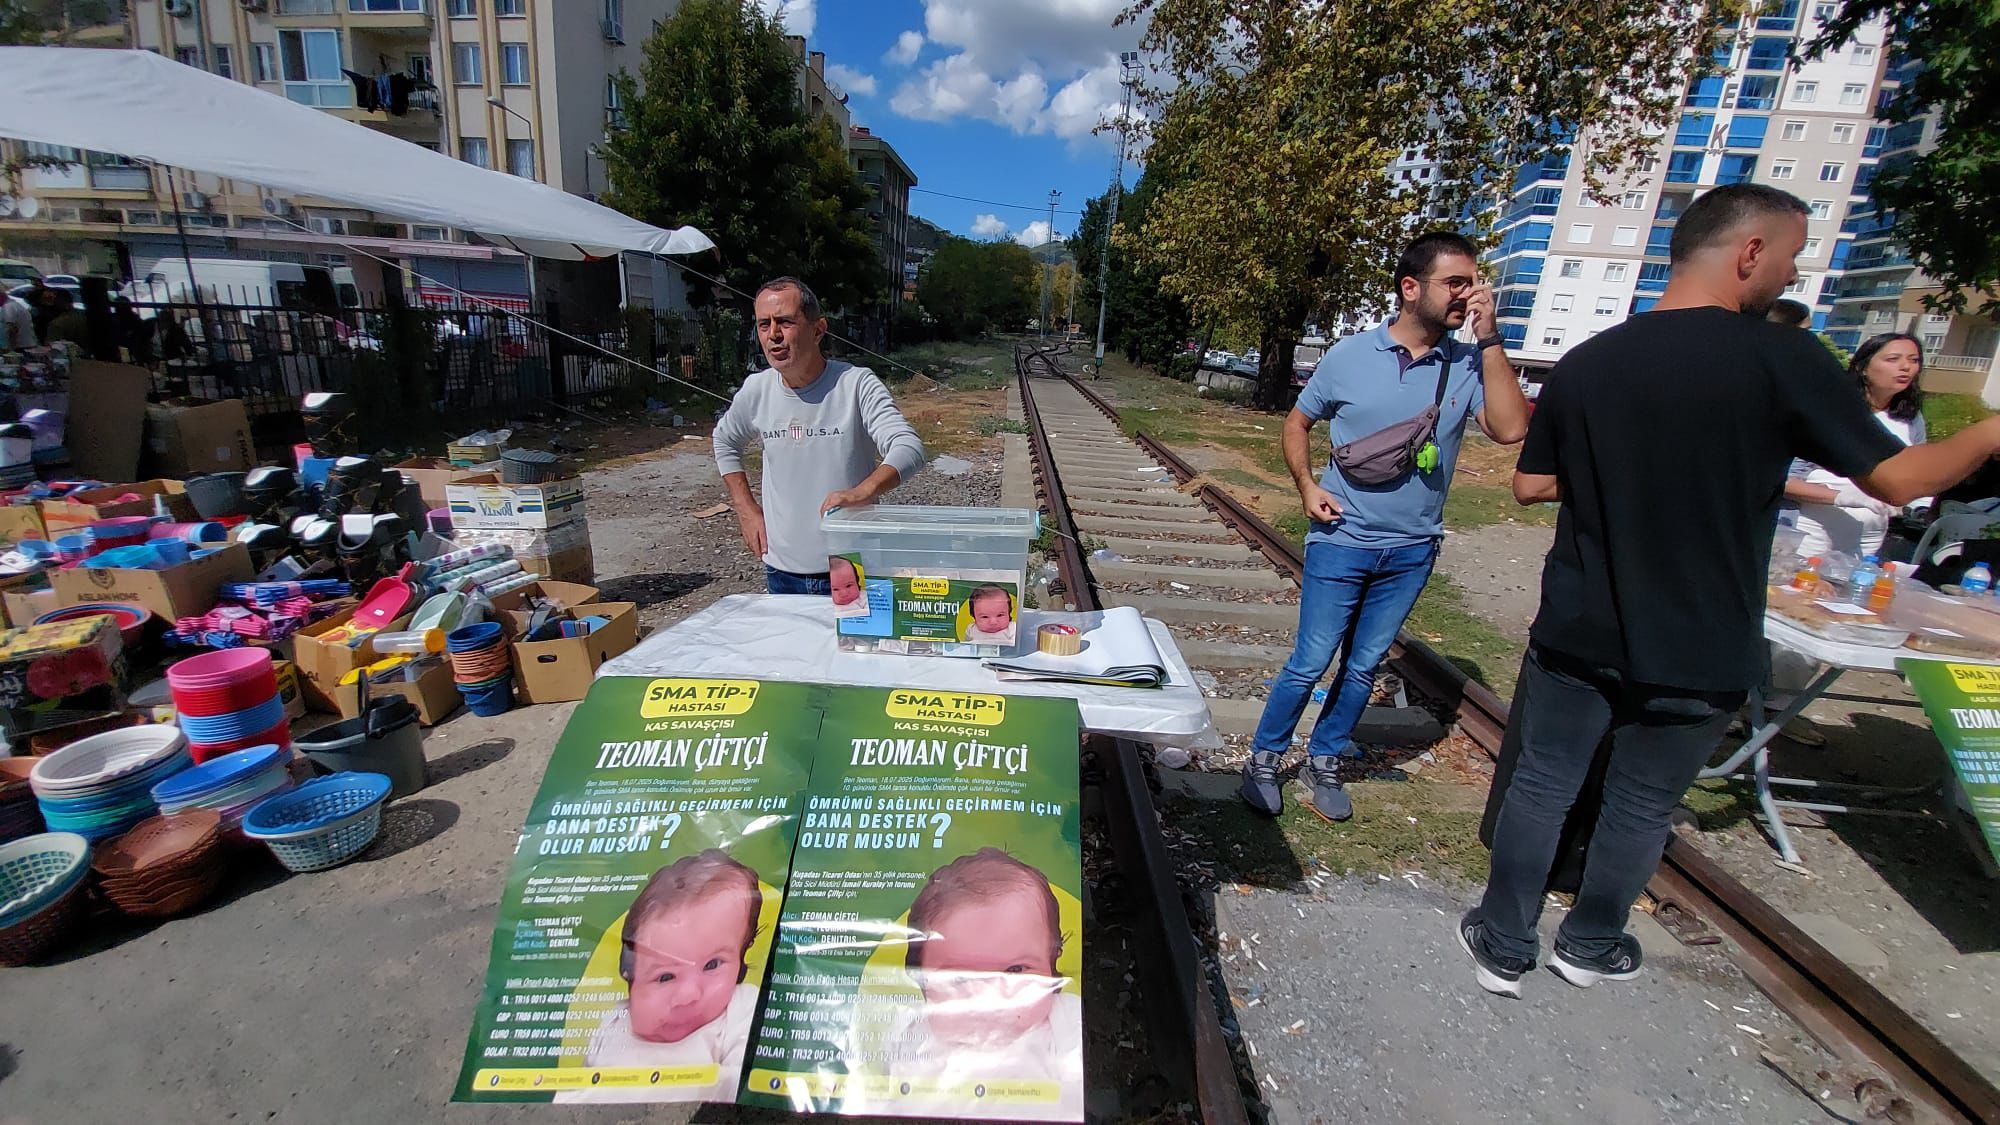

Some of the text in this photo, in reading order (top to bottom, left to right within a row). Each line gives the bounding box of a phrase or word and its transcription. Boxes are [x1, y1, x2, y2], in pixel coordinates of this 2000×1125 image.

[480, 501, 514, 516] BONITA
[897, 600, 960, 615] TEOMAN ÇİFTÇİ
[1954, 670, 1986, 680] SMA
[650, 682, 755, 701] SMA TİP-1
[668, 702, 726, 713] HASTASI
[894, 693, 1003, 712] SMA TİP-1
[916, 709, 976, 721] HASTASI
[644, 719, 735, 732] KAS SAVAŞÇISI
[894, 722, 990, 737] KAS SAVAŞÇISI
[595, 731, 769, 772] TEOMAN ÇİFTÇİ
[850, 738, 1029, 775] TEOMAN ÇİFTÇİ
[551, 795, 788, 816] ÖMRÜMÜ SAĞLIKLI GEÇİRMEM İÇİN
[809, 795, 1062, 816] ÖMRÜMÜ SAĞLIKLI GEÇİRMEM İÇİN
[545, 815, 659, 835] BANA DESTEK
[805, 813, 927, 829] BANA DESTEK
[539, 813, 681, 856] OLUR MUSUN ?
[800, 812, 952, 849] OLUR MUSUN ?
[534, 917, 560, 926] TEOMAN
[561, 915, 582, 927] ÇİFTÇİ
[801, 911, 832, 920] TEOMAN
[834, 910, 859, 922] ÇİFTÇİ
[546, 928, 573, 937] TEOMAN
[502, 995, 509, 1005] TL
[768, 990, 778, 1001] TL
[760, 1026, 783, 1039] EURO
[484, 1046, 508, 1057] DOLAR
[756, 1044, 785, 1059] DOLAR
[792, 1048, 813, 1060] TR32
